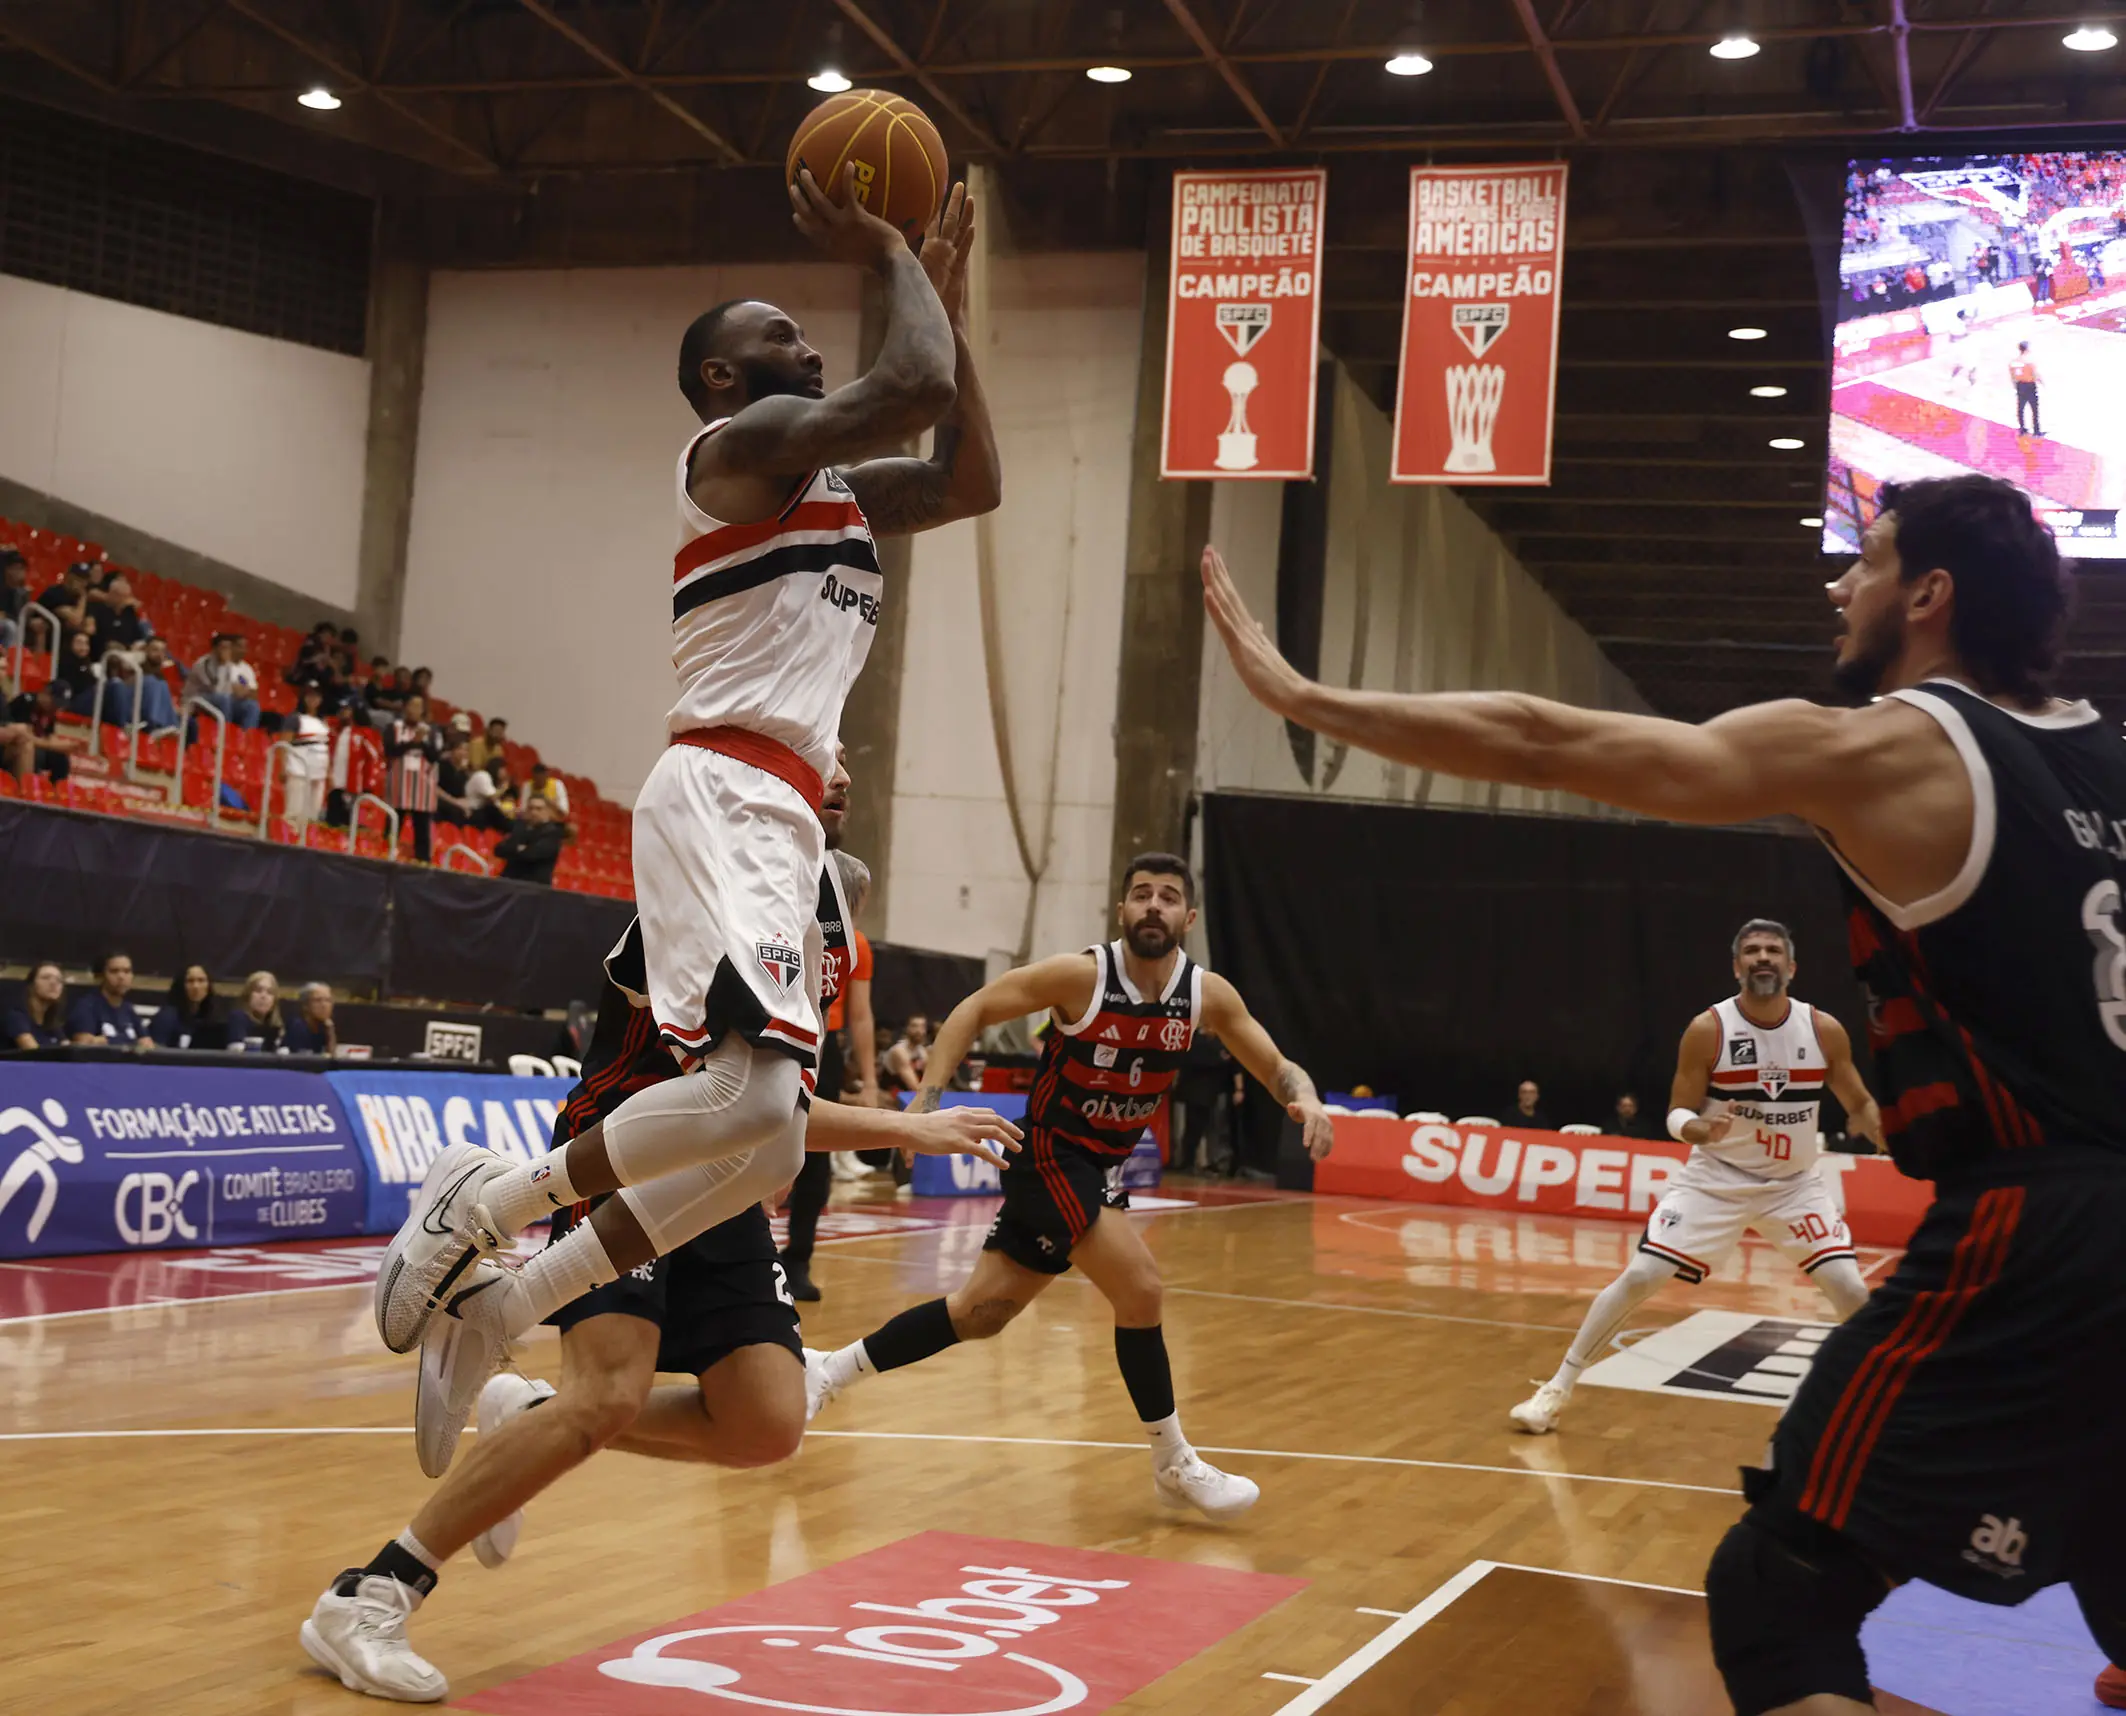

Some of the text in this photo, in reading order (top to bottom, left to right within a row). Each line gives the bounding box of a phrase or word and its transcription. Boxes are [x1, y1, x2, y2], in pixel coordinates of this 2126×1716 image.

[1182, 181, 1315, 205] CAMPEONATO
[1418, 177, 1556, 205] BASKETBALL
[1181, 203, 1314, 234] PAULISTA
[1180, 232, 1313, 259] DE BASQUETE
[1178, 267, 1311, 298] CAMPEÃO
[1413, 264, 1552, 298] CAMPEÃO
[761, 947, 800, 966] SPFC
[431, 1032, 474, 1059] SPFC
[1129, 1057, 1144, 1088] 6
[86, 1103, 336, 1146] FORMAÇÃO DE ATLETAS
[1735, 1105, 1815, 1125] SUPERBET
[1756, 1129, 1791, 1160] 40
[223, 1167, 282, 1200] COMITÊ
[115, 1170, 199, 1244] CBC
[270, 1198, 327, 1227] CLUBES
[1788, 1212, 1829, 1244] 40
